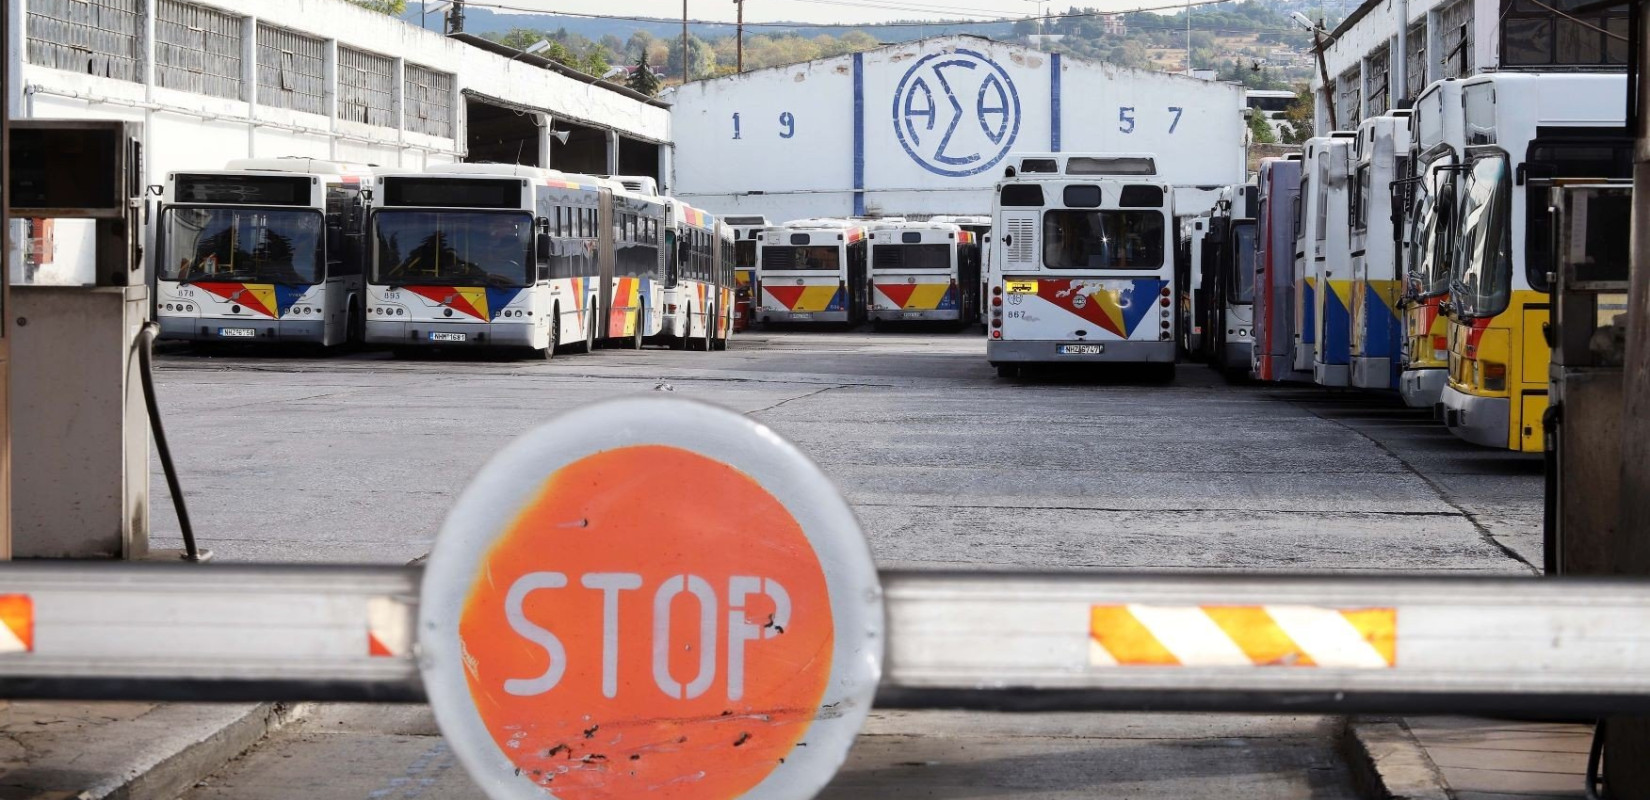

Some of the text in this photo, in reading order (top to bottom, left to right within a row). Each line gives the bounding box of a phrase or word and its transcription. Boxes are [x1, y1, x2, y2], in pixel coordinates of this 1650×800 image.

[178, 290, 194, 298] 878
[384, 292, 400, 300] 893
[1007, 310, 1026, 319] 867
[503, 571, 792, 702] STOP
